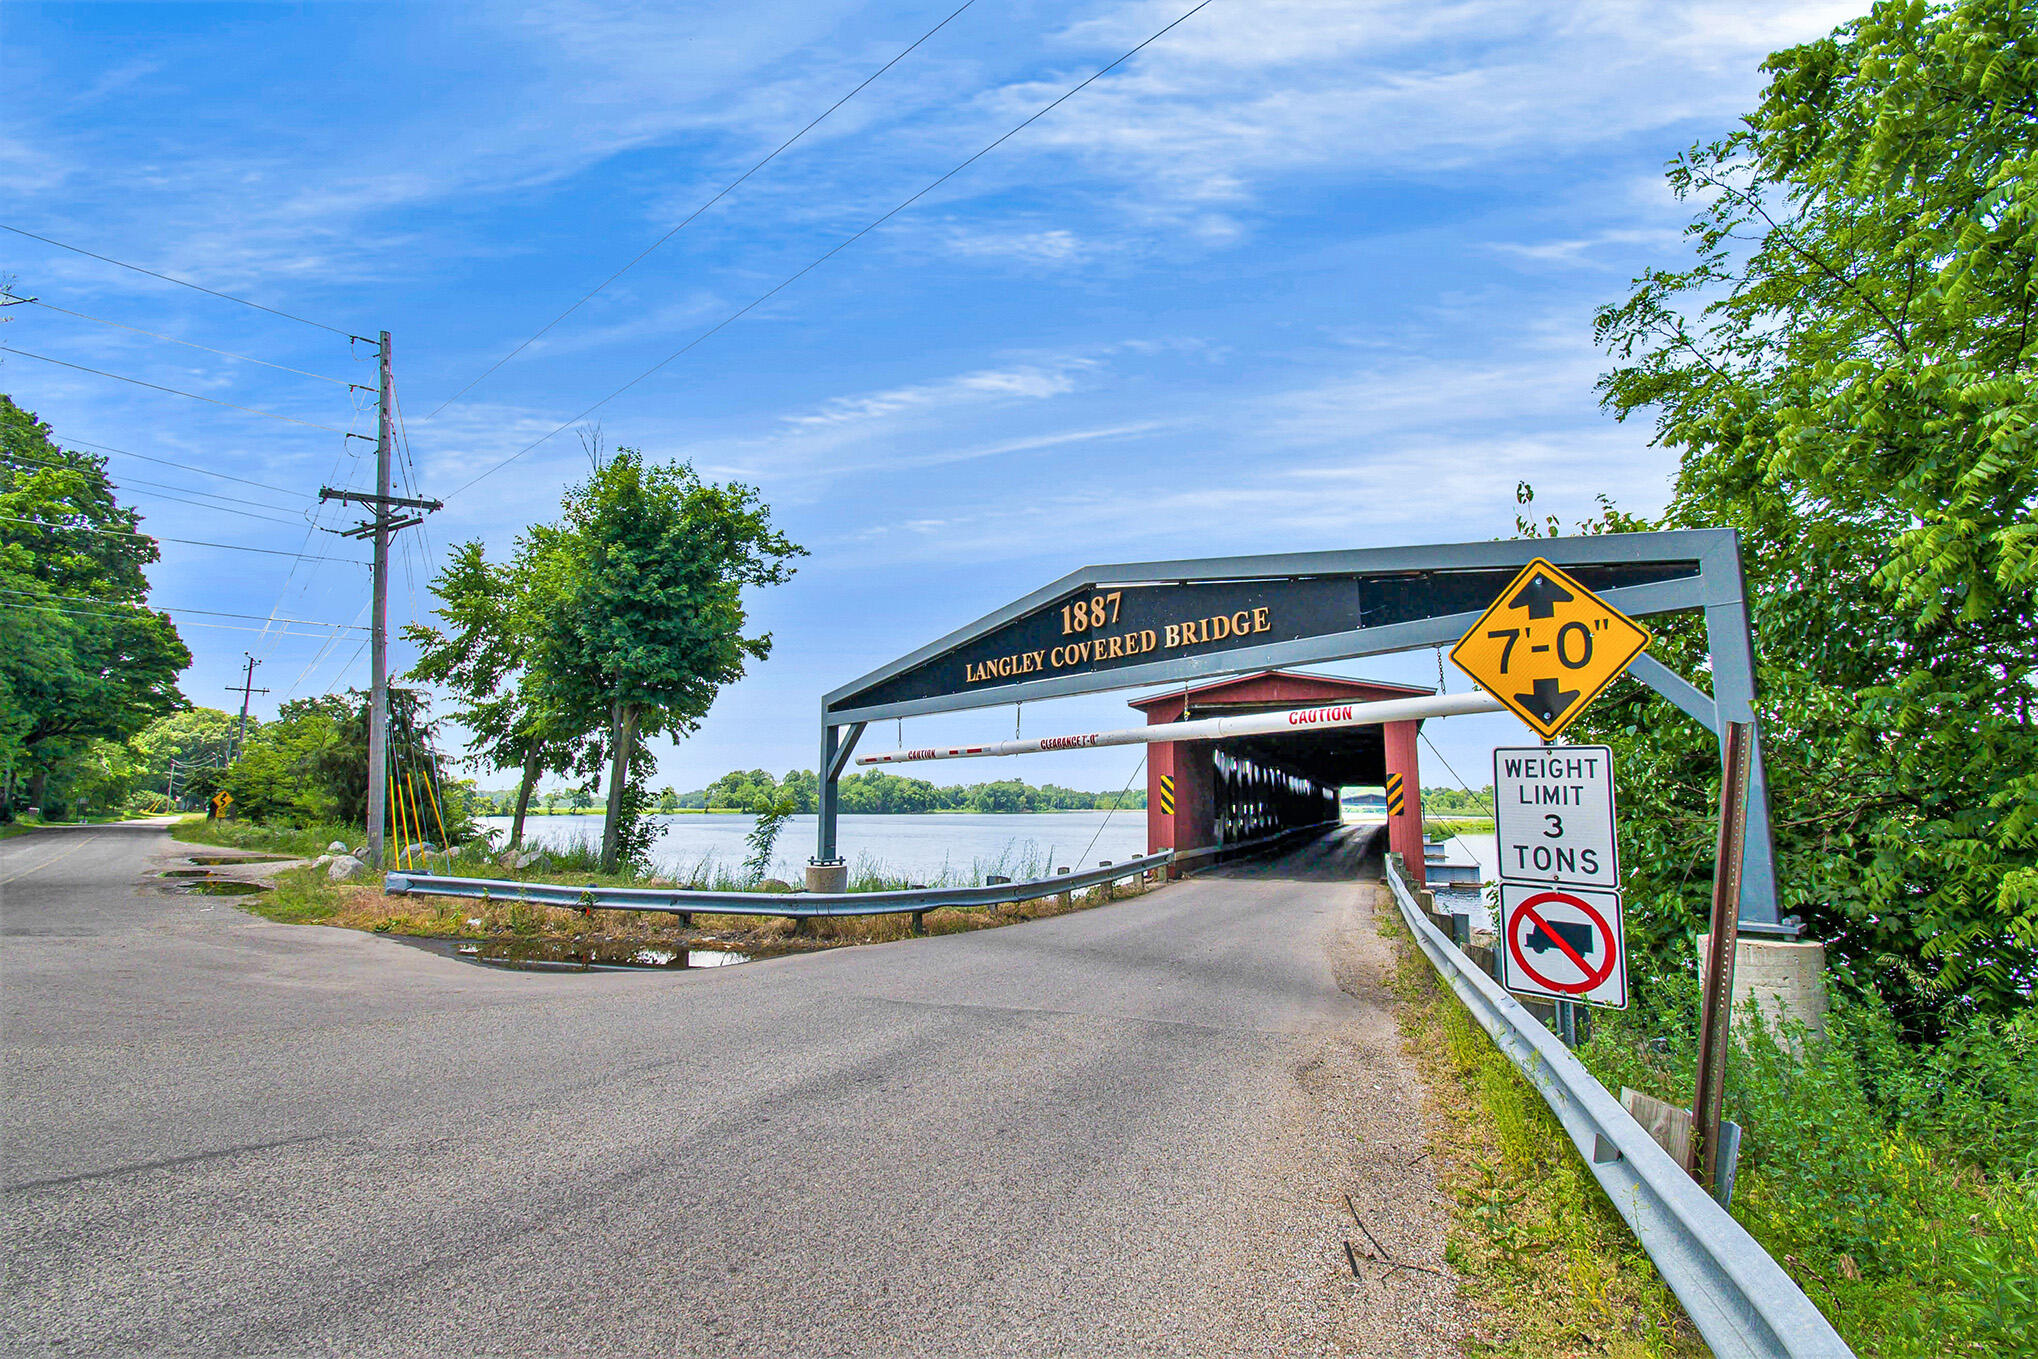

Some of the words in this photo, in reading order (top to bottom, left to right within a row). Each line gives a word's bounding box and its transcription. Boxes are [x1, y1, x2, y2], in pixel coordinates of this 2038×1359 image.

[1061, 591, 1122, 635] 1887
[965, 650, 1045, 683] LANGLEY
[1050, 630, 1157, 667] COVERED
[1164, 606, 1272, 648] BRIDGE
[1288, 706, 1353, 725] CAUTION
[1040, 736, 1080, 750] CLEARANCE
[908, 749, 937, 760] CAUTION
[1504, 758, 1598, 778] WEIGHT
[1519, 784, 1584, 806] LIMIT
[1543, 813, 1564, 838] 3
[1512, 844, 1599, 875] TONS
